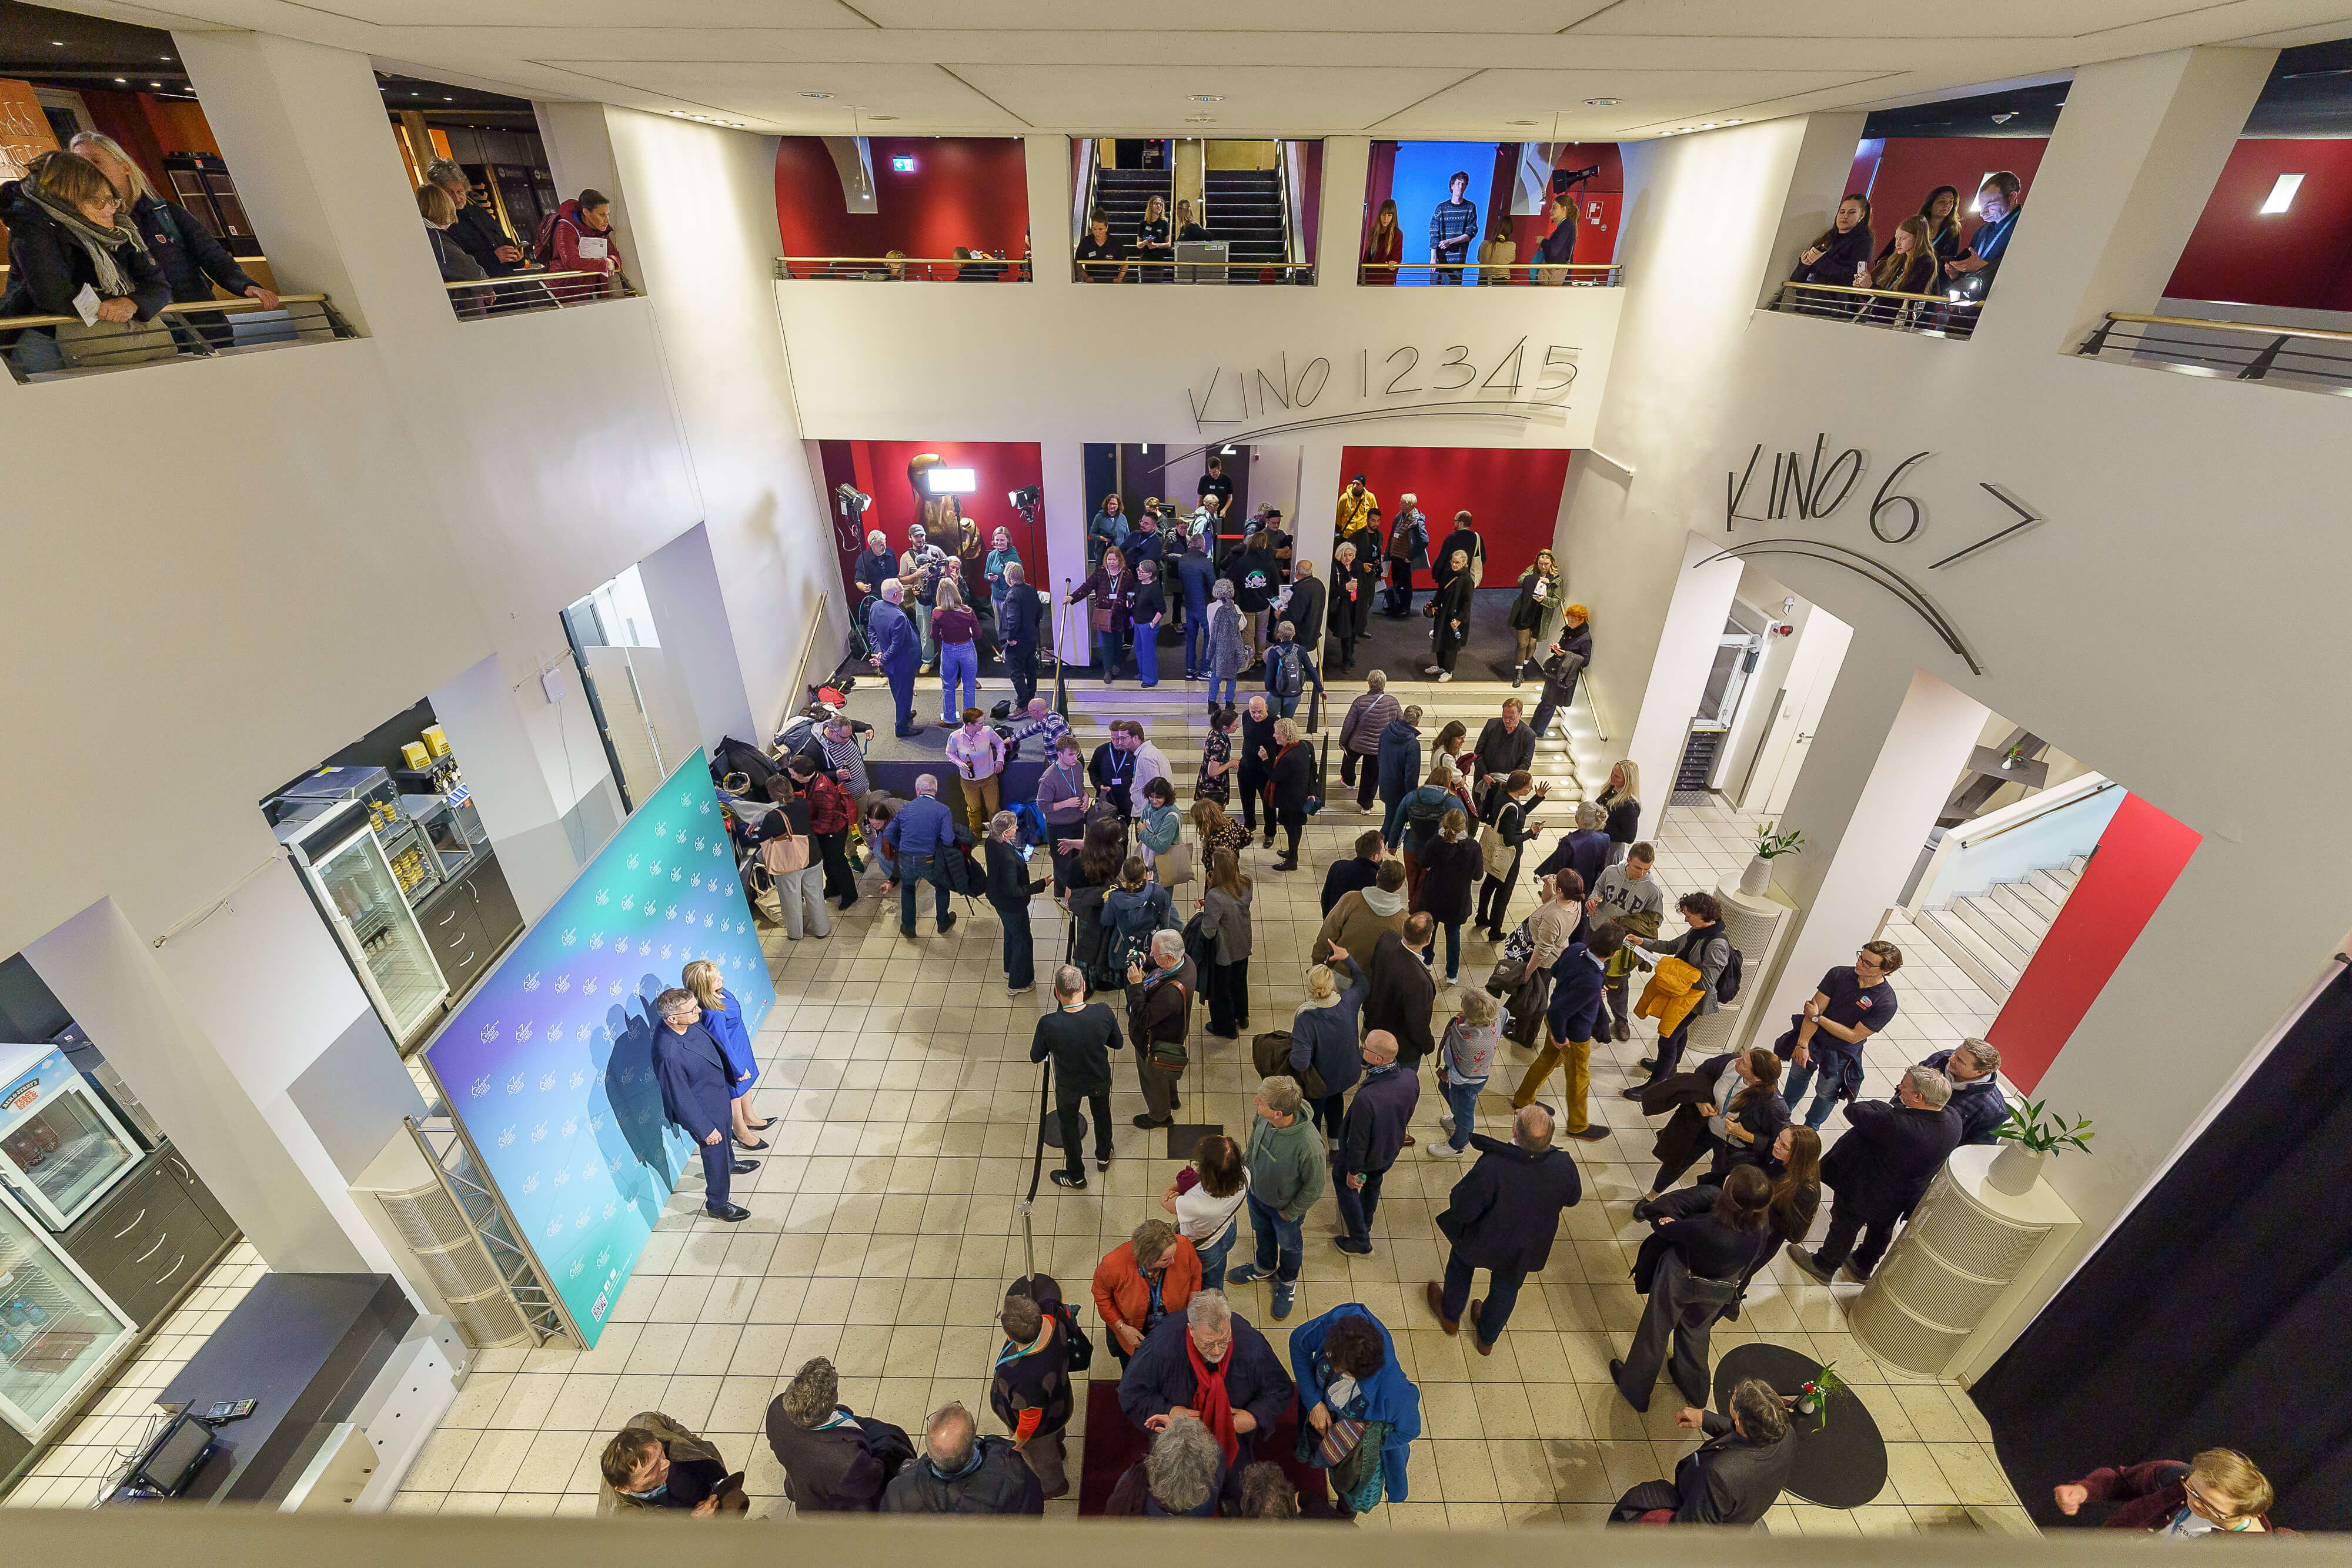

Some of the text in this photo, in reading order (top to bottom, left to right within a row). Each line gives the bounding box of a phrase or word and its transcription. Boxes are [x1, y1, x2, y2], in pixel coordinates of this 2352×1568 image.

[1188, 351, 1330, 434] KINO
[1726, 433, 1930, 543] KINO 6
[1605, 885, 1643, 913] GAP
[561, 928, 569, 944] 67
[523, 974, 531, 991] 67
[554, 975, 562, 992] 67
[480, 1023, 489, 1041] 67
[515, 1024, 523, 1041] 67
[547, 1024, 554, 1041] 67
[471, 1077, 480, 1096] 67
[507, 1076, 514, 1093] 67
[2, 1097, 13, 1108] BEN
[16, 1079, 38, 1095] JERRY'S
[14, 1090, 34, 1105] PEACE
[18, 1095, 32, 1107] LOVE
[498, 1128, 506, 1146] 67
[531, 1124, 539, 1142] 67
